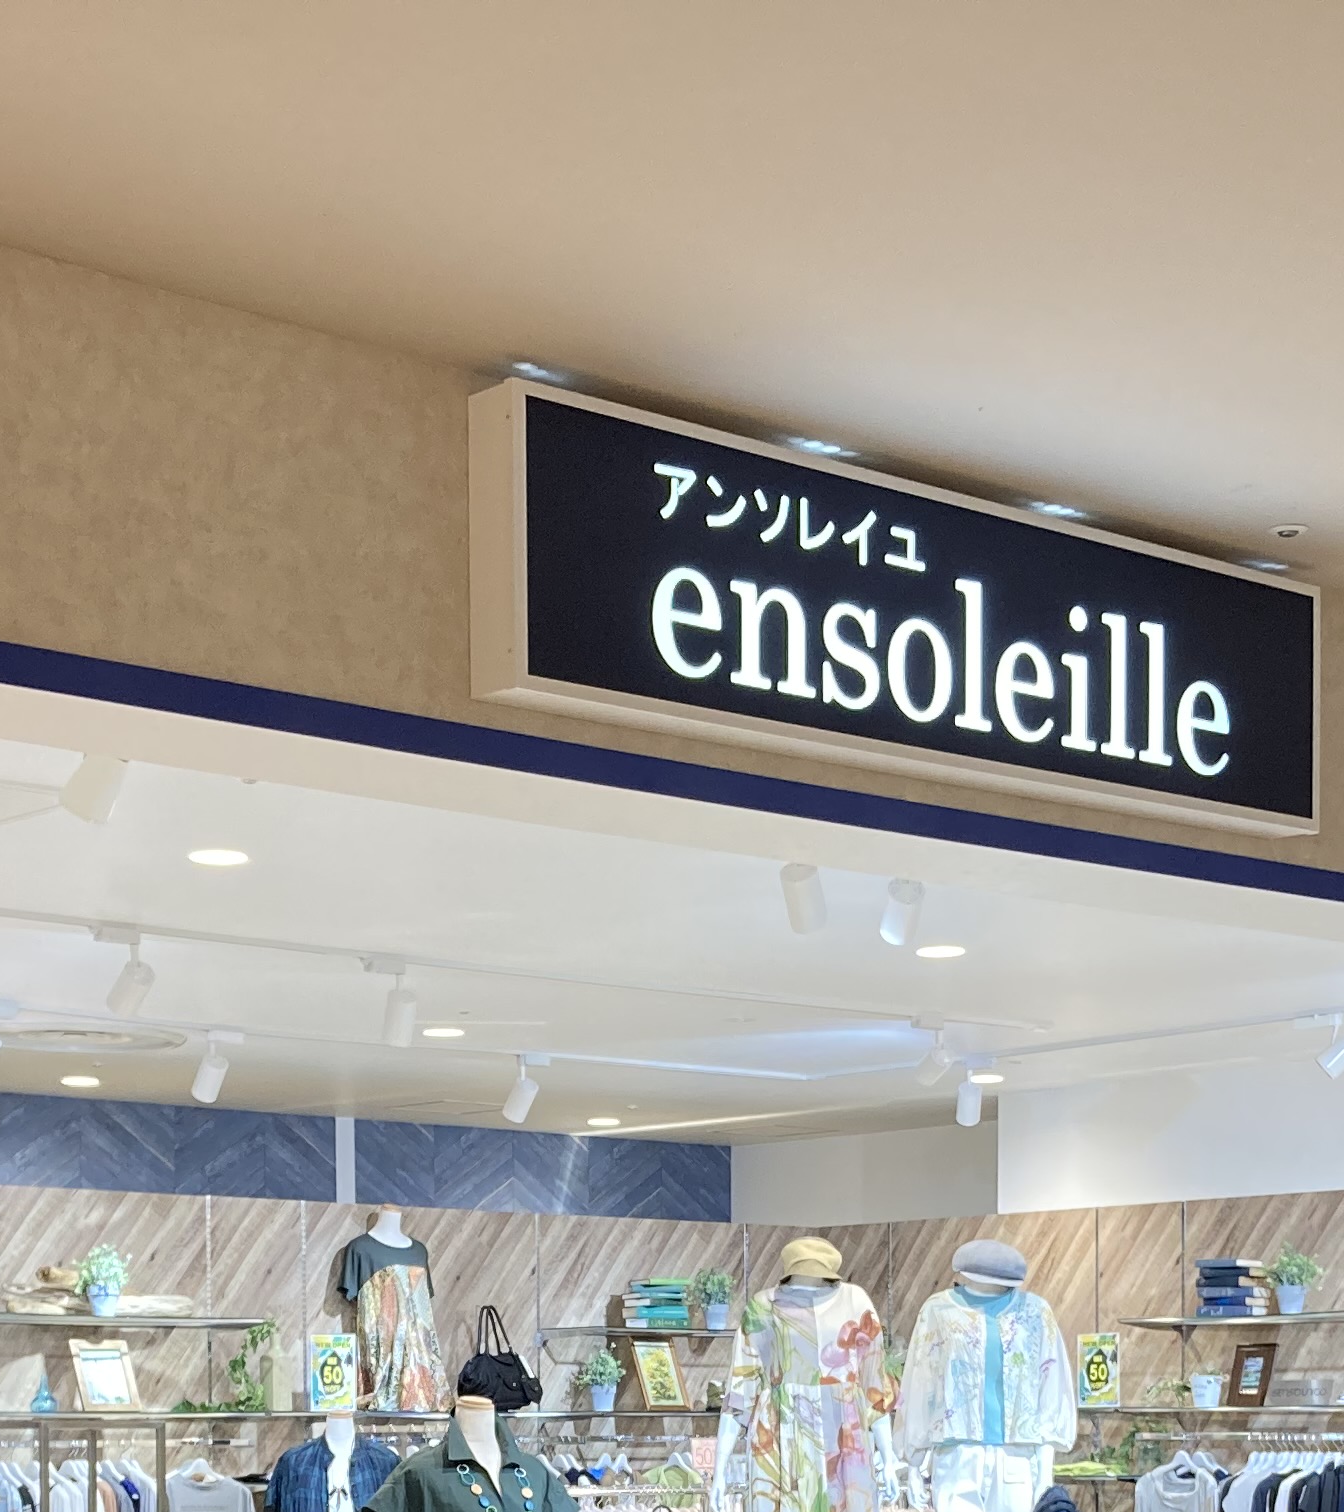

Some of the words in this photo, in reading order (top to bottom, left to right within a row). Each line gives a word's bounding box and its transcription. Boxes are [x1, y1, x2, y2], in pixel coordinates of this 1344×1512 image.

[653, 462, 926, 573] アンソレイユ
[651, 565, 1233, 778] ensoleille
[323, 1365, 343, 1385] 50
[1089, 1363, 1108, 1381] 50
